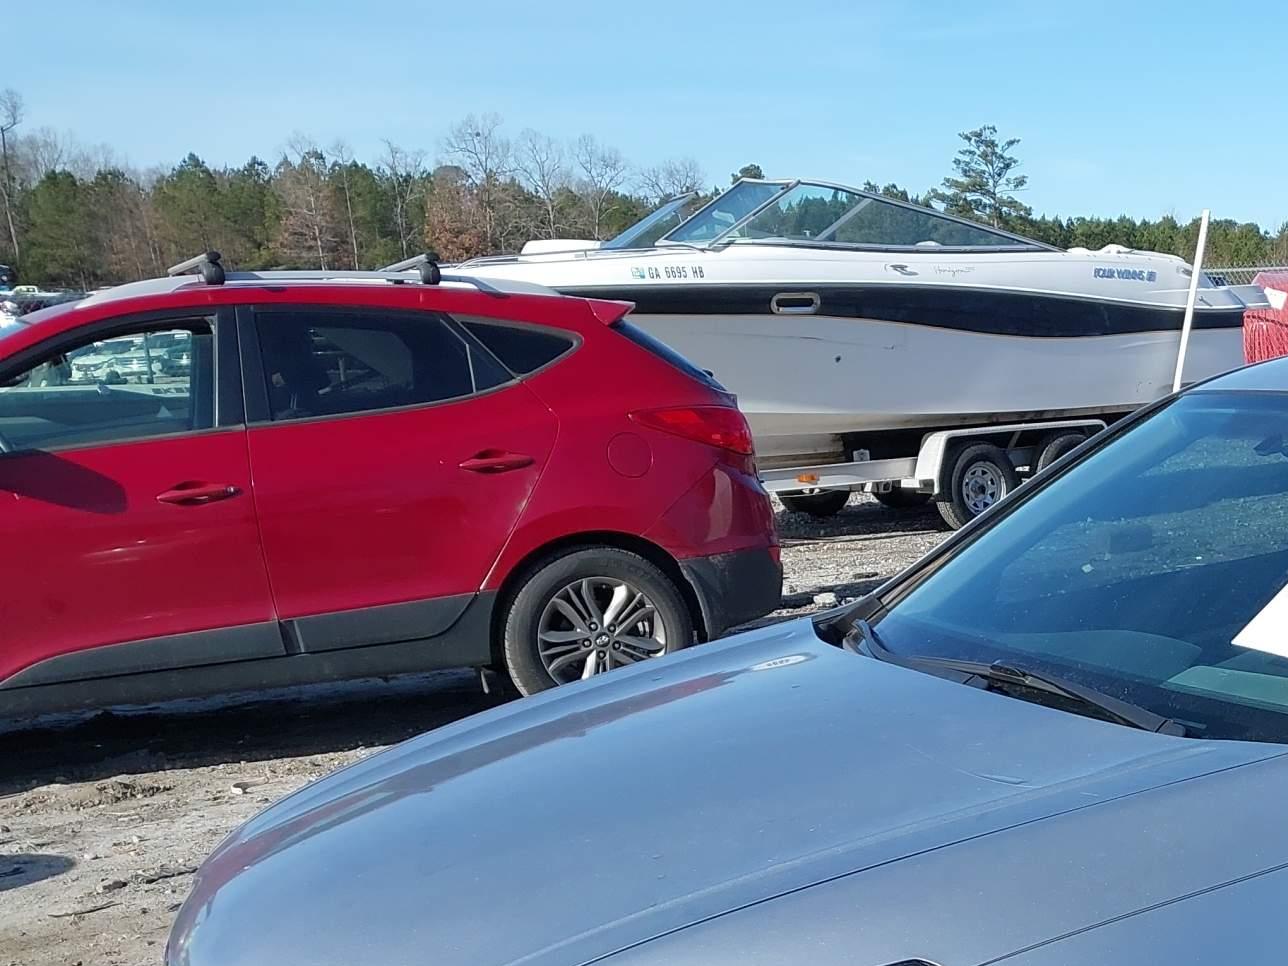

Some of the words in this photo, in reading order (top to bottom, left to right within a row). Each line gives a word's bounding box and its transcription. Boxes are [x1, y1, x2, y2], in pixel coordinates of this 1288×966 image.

[648, 266, 661, 279] GA
[664, 266, 688, 279] 6695
[691, 266, 705, 279] HB
